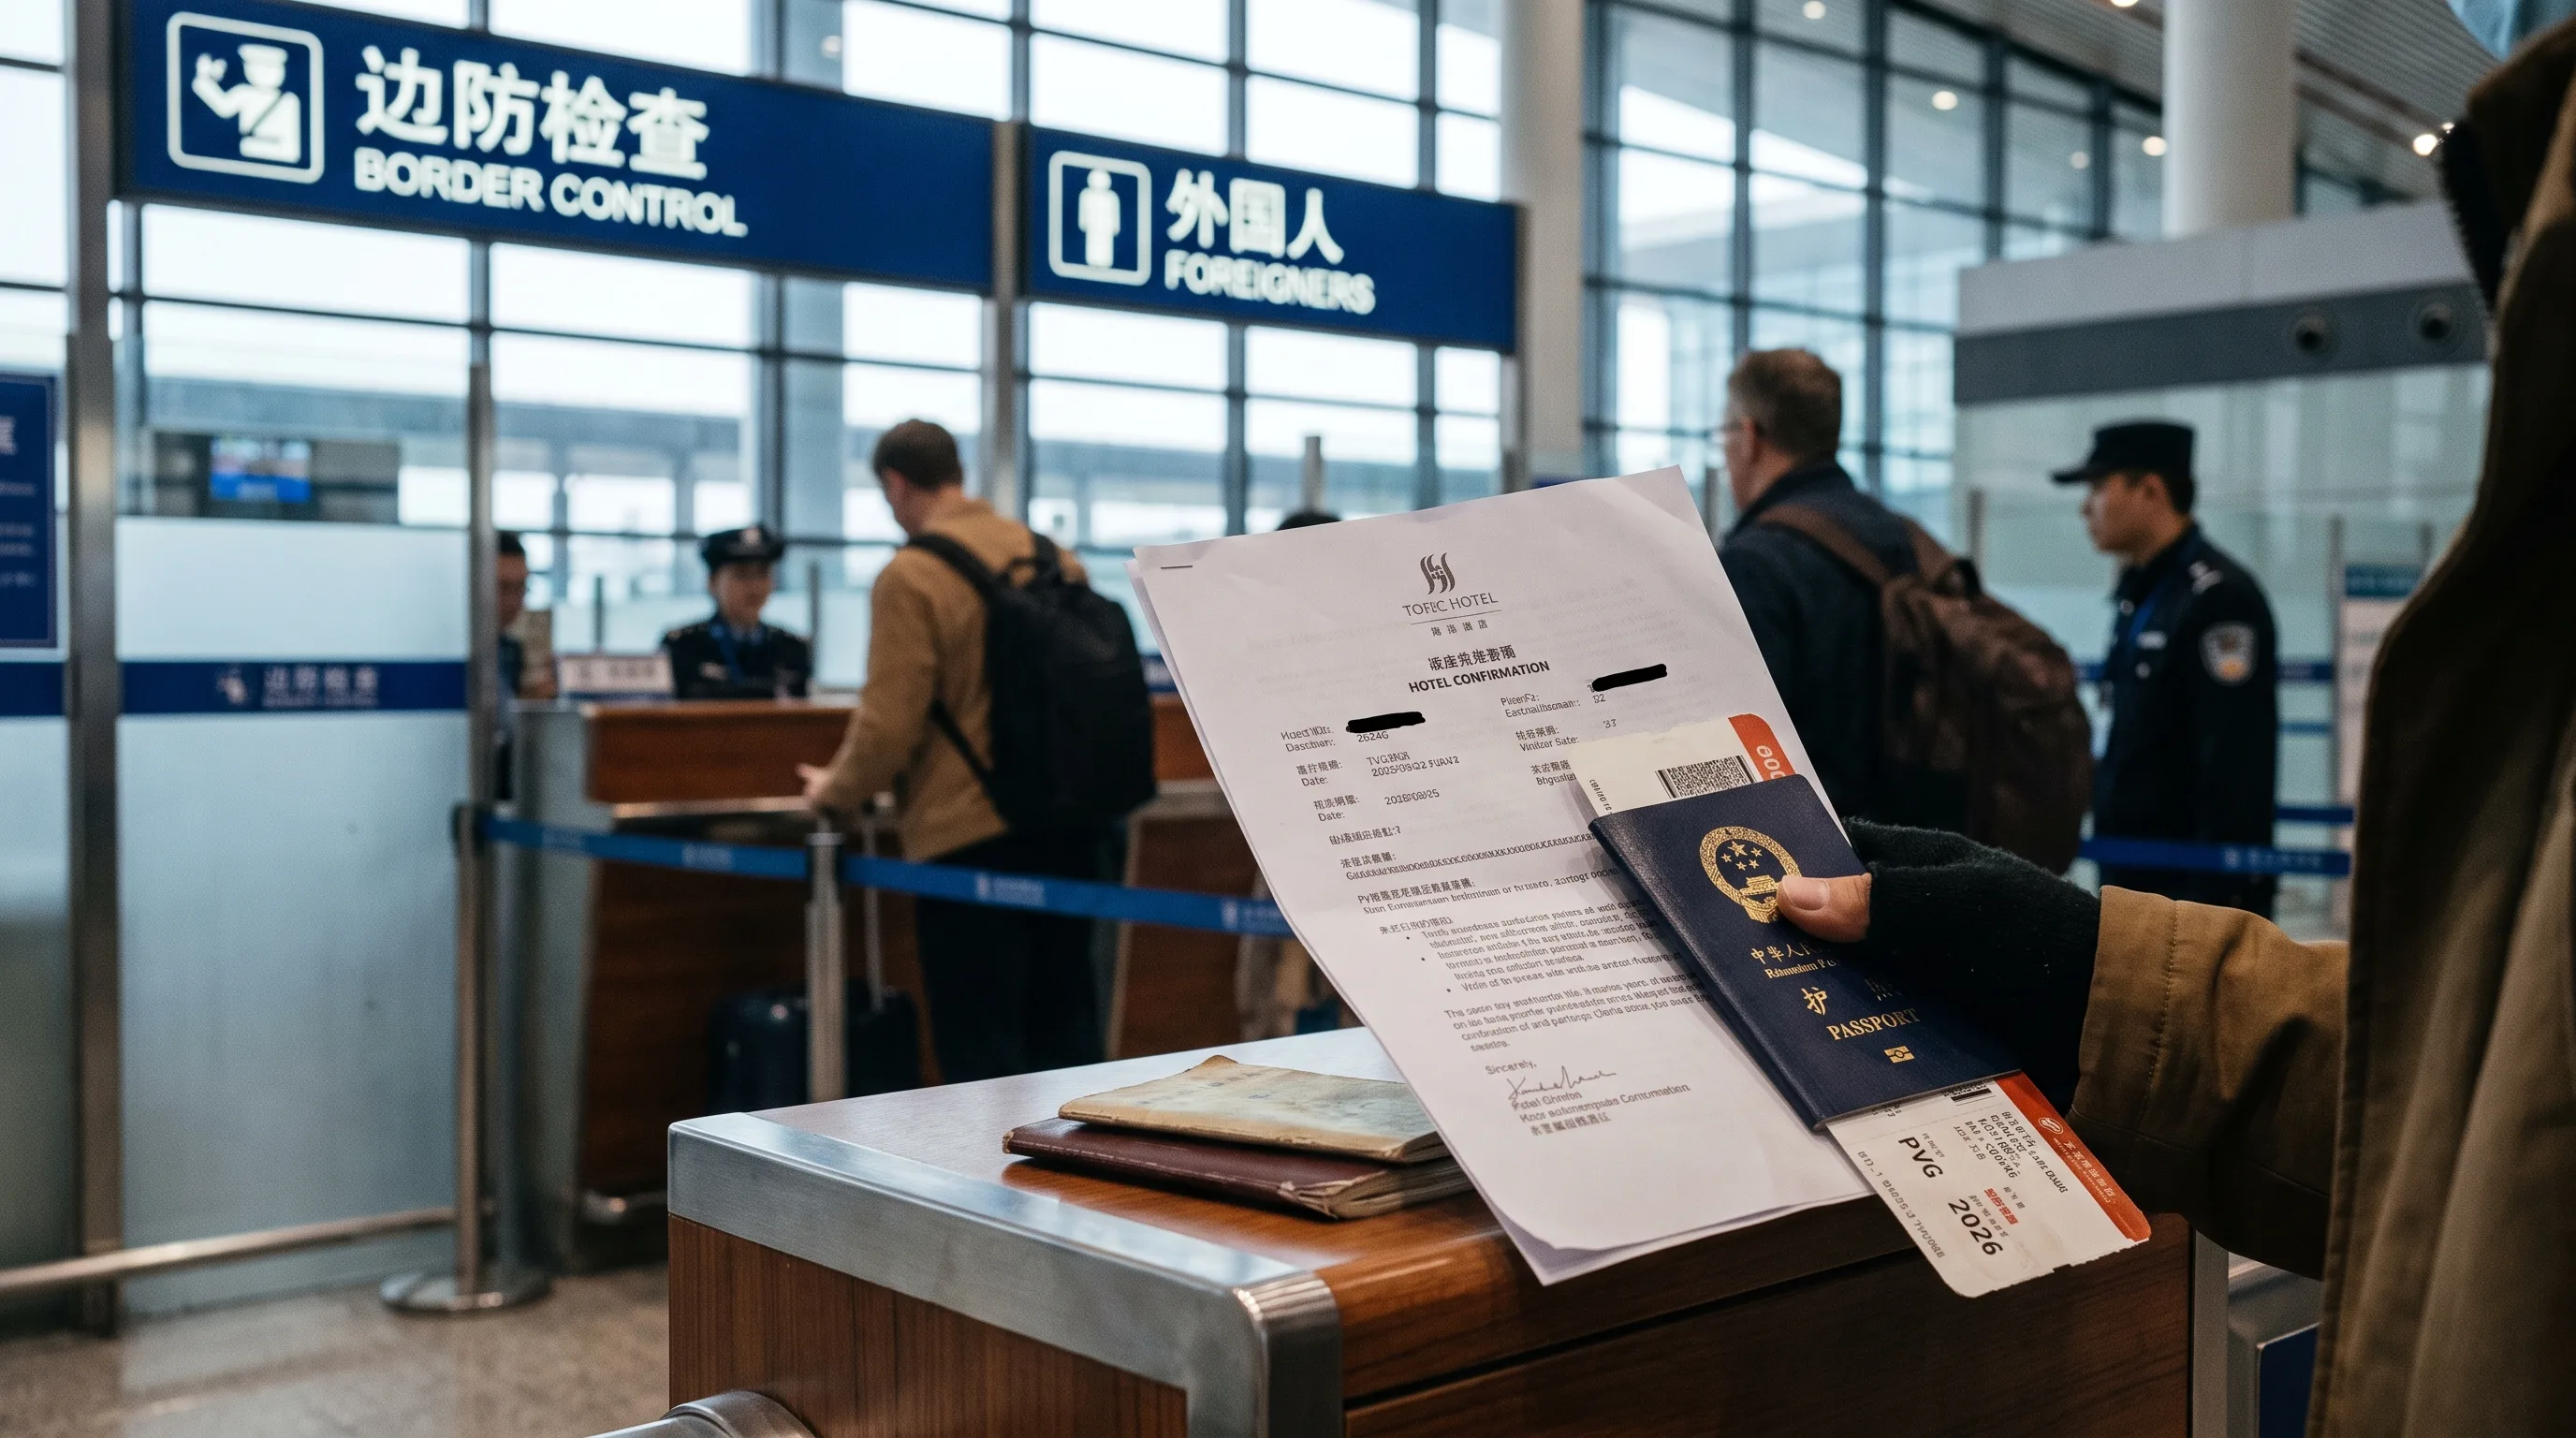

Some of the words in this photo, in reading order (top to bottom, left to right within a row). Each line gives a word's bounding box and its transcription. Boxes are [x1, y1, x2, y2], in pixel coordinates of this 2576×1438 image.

[355, 44, 710, 181] 边防检查
[354, 146, 546, 213] BORDER
[549, 172, 748, 238] CONTROL
[1164, 168, 1345, 265] 外国人
[1164, 248, 1376, 315] FOREIGNERS
[1449, 592, 1499, 610] HOTEL
[1409, 677, 1452, 693] HOTEL
[1453, 660, 1550, 686] CONFIRMATION
[1301, 776, 1329, 787] Date:
[1318, 811, 1345, 822] Date:
[1826, 1007, 1921, 1041] PASSPORT
[1897, 1136, 1943, 1180] PVG
[1948, 1198, 2004, 1256] 2026
